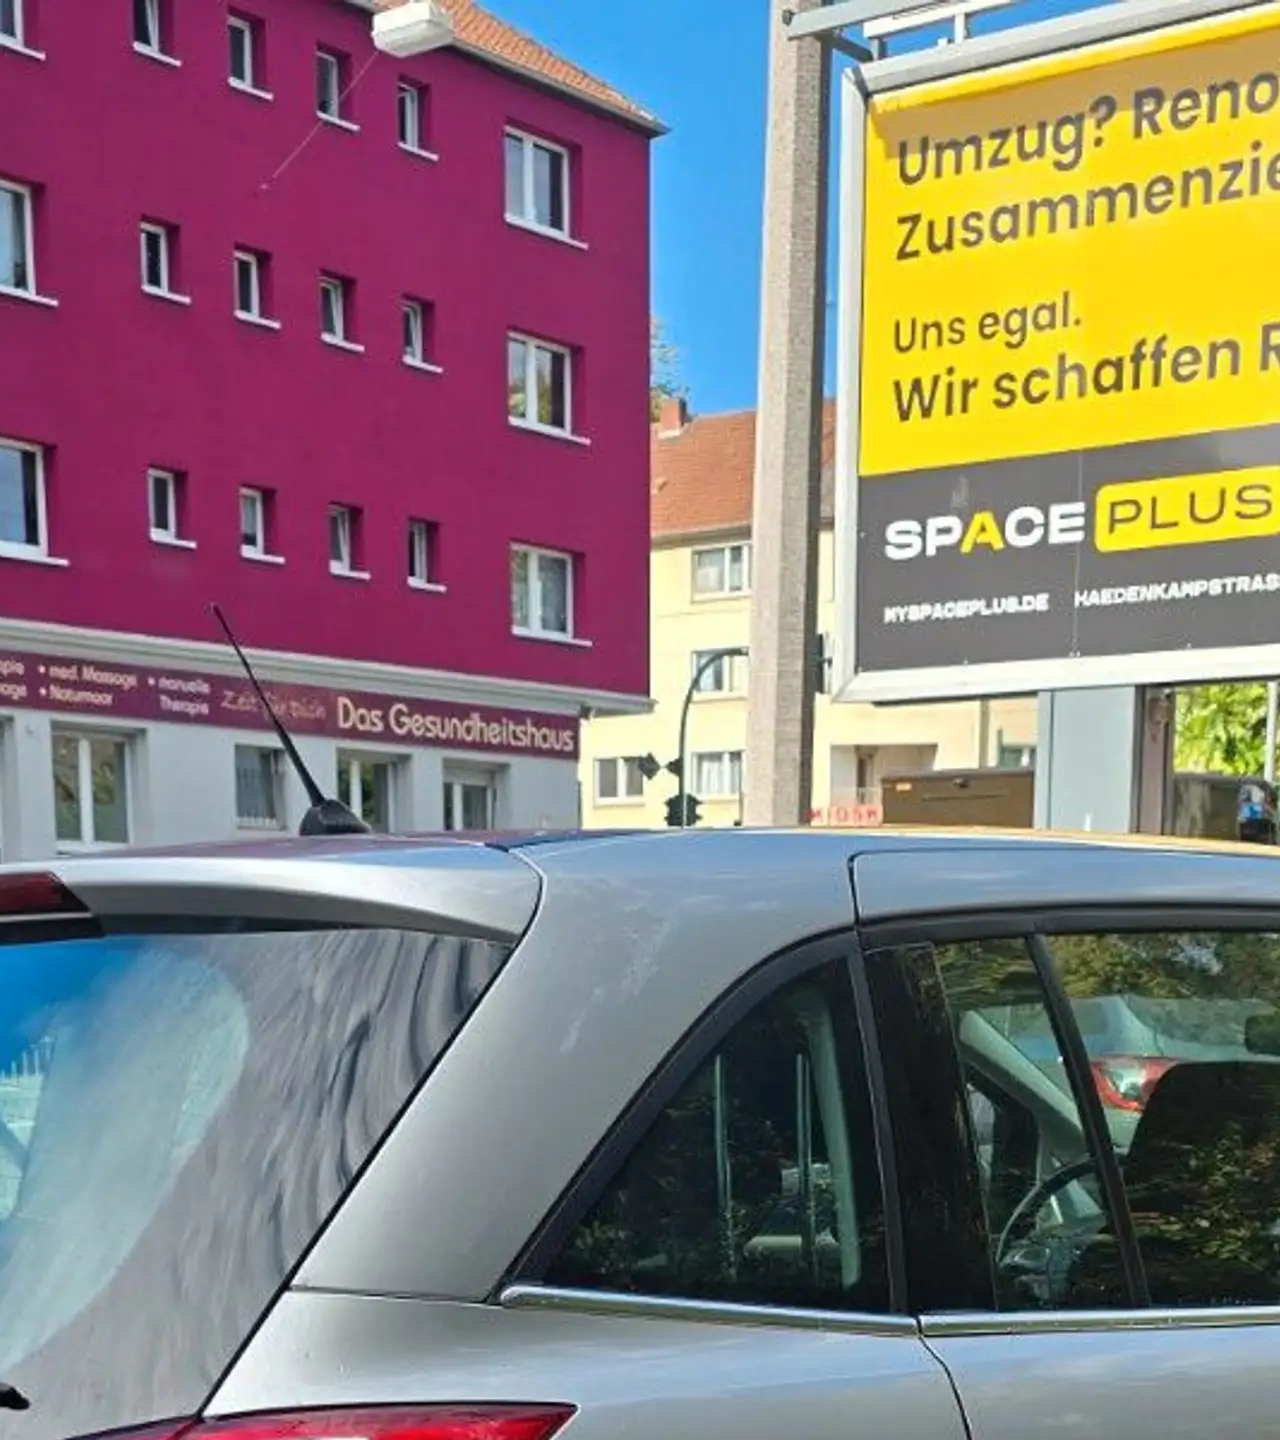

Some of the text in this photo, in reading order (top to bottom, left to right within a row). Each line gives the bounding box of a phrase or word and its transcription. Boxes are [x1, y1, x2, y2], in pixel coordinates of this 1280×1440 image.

[898, 95, 1118, 186] Umzug?
[893, 291, 1082, 353] Uns egal.
[893, 367, 979, 422] Wir
[993, 335, 1241, 409] schaffen
[884, 483, 1274, 560] SPACE PLUS
[336, 695, 575, 752] Das Gesundheitshaus
